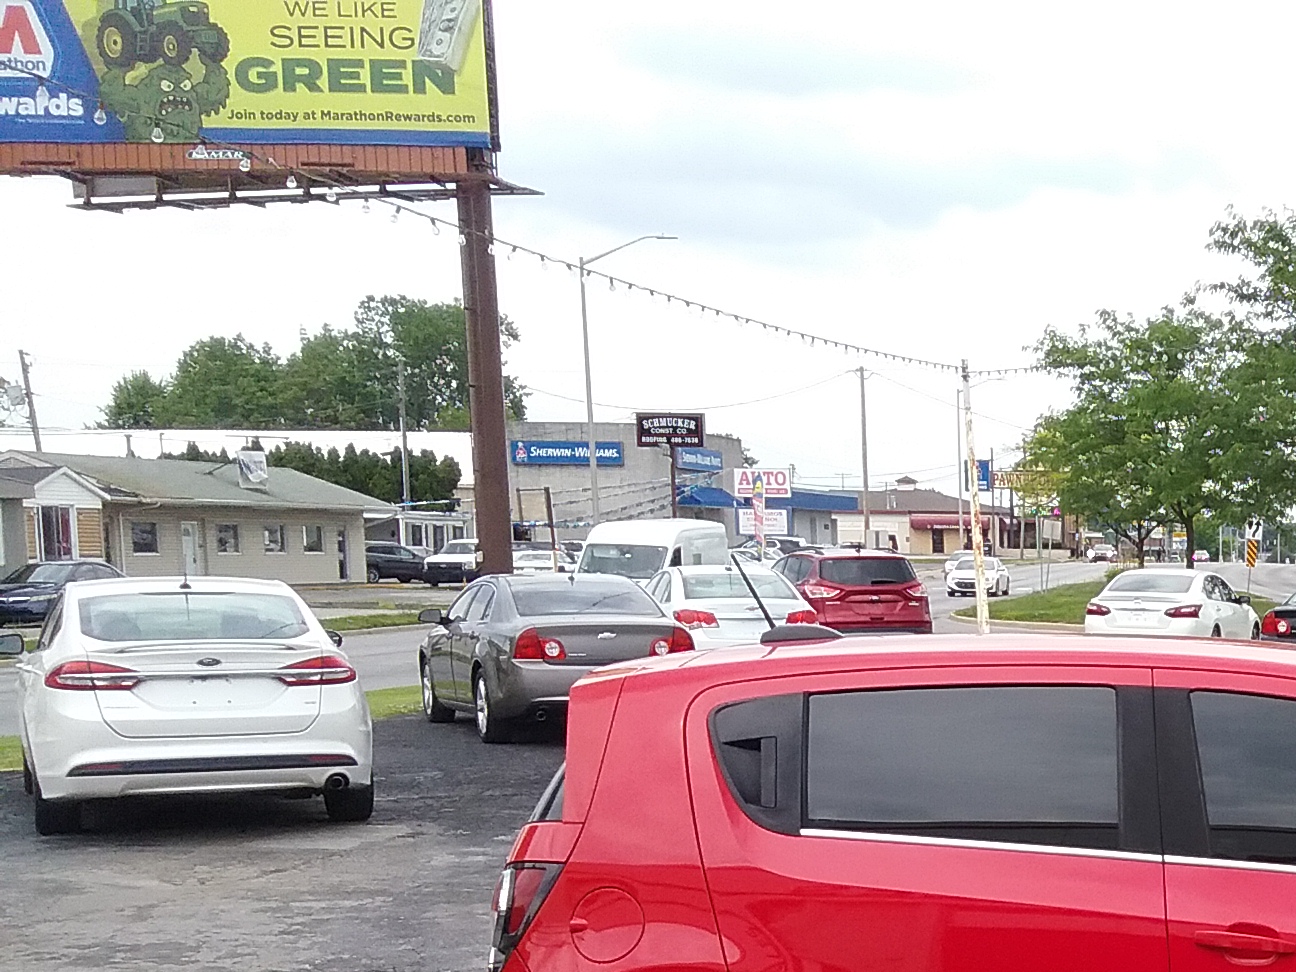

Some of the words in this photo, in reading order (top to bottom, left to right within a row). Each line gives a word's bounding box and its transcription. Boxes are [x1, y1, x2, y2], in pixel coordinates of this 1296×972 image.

[284, 1, 328, 17] WE
[337, 1, 398, 18] LIKE
[269, 25, 416, 49] SEEING
[234, 57, 456, 95] GREEN
[227, 109, 256, 121] Join
[259, 110, 298, 123] today
[303, 111, 317, 121] at
[321, 110, 476, 123] MarathonRewards.com
[641, 417, 696, 430] SCHMUCKER
[529, 446, 619, 457] SHERWIN-WIIAMS
